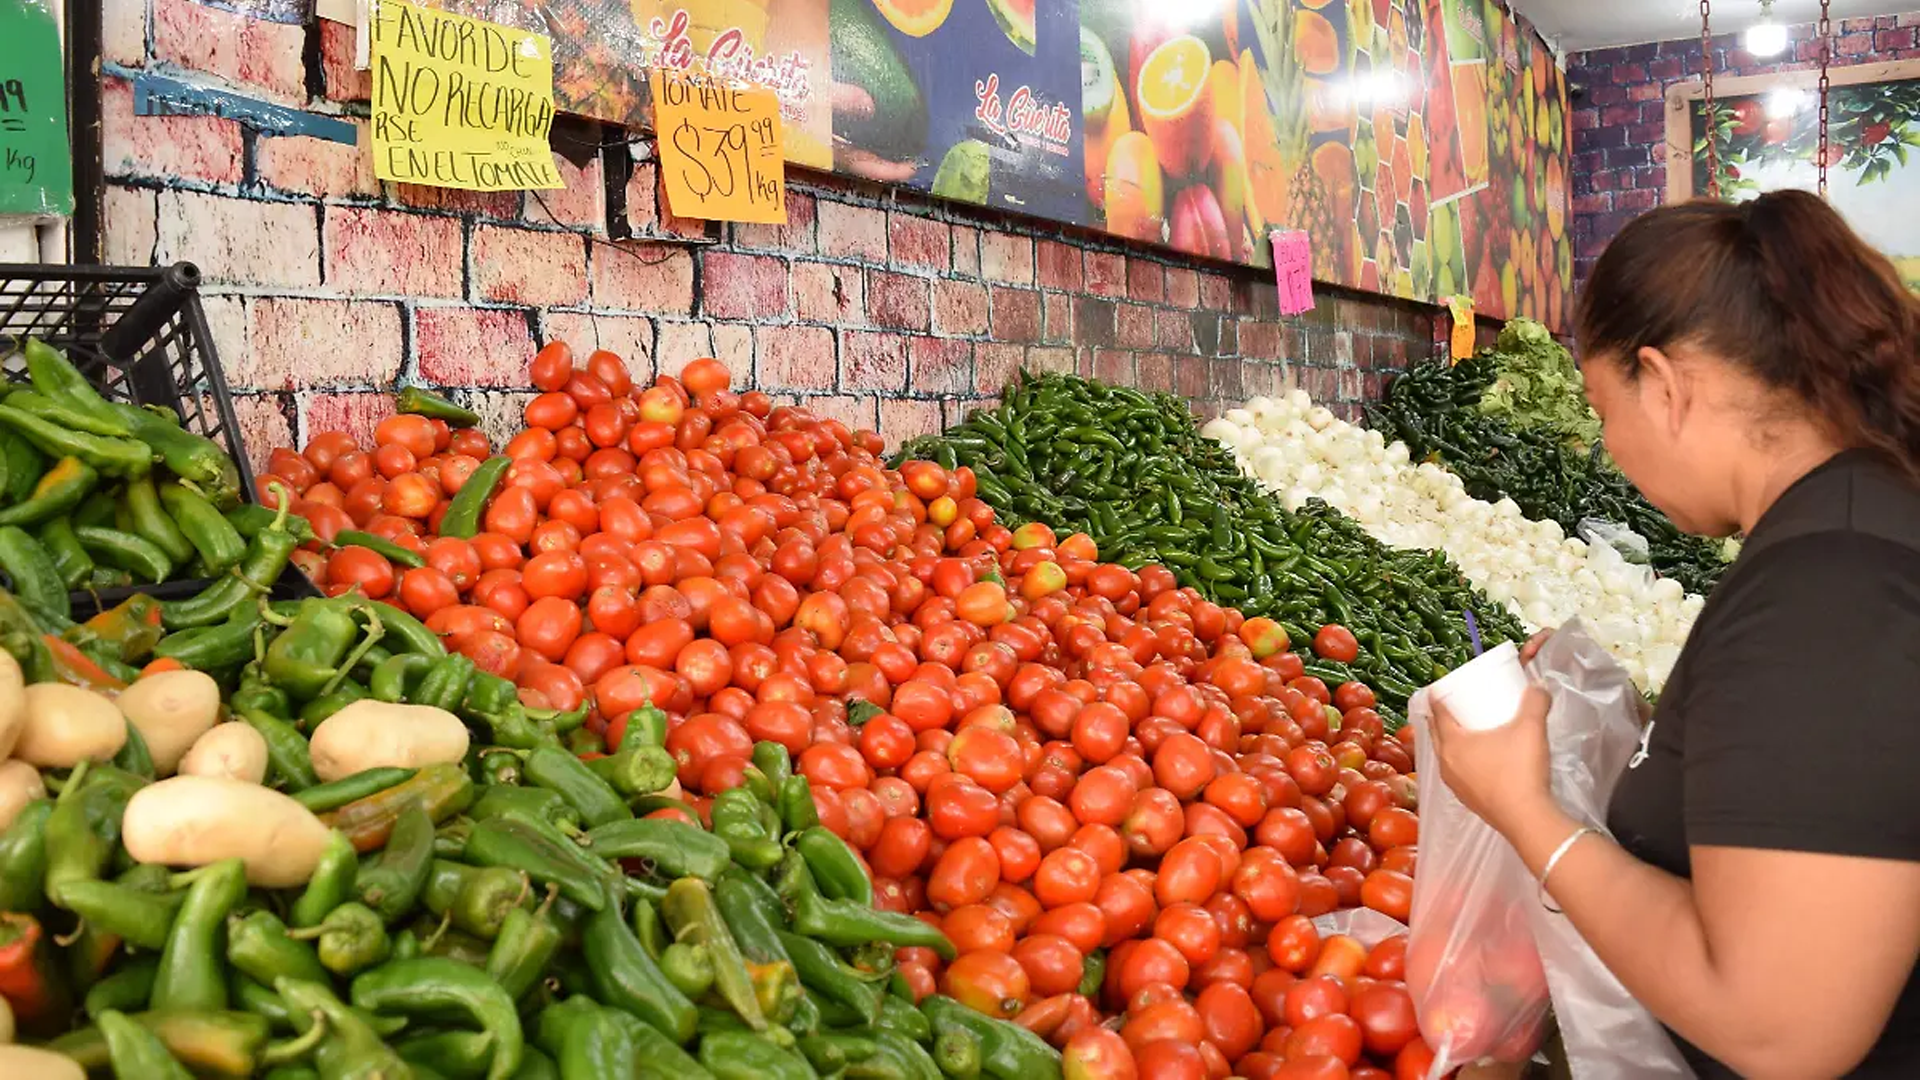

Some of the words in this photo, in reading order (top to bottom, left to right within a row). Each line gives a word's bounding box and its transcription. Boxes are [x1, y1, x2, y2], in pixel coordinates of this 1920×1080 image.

[374, 1, 476, 67] FAVOR
[483, 28, 532, 78] DE
[379, 55, 439, 115] NO
[444, 71, 551, 140] RECARGA
[656, 68, 751, 112] TOMATE
[976, 73, 1006, 136] La
[1006, 85, 1071, 143] Güerita
[375, 112, 423, 142] RSE
[461, 152, 556, 187] TOMATE
